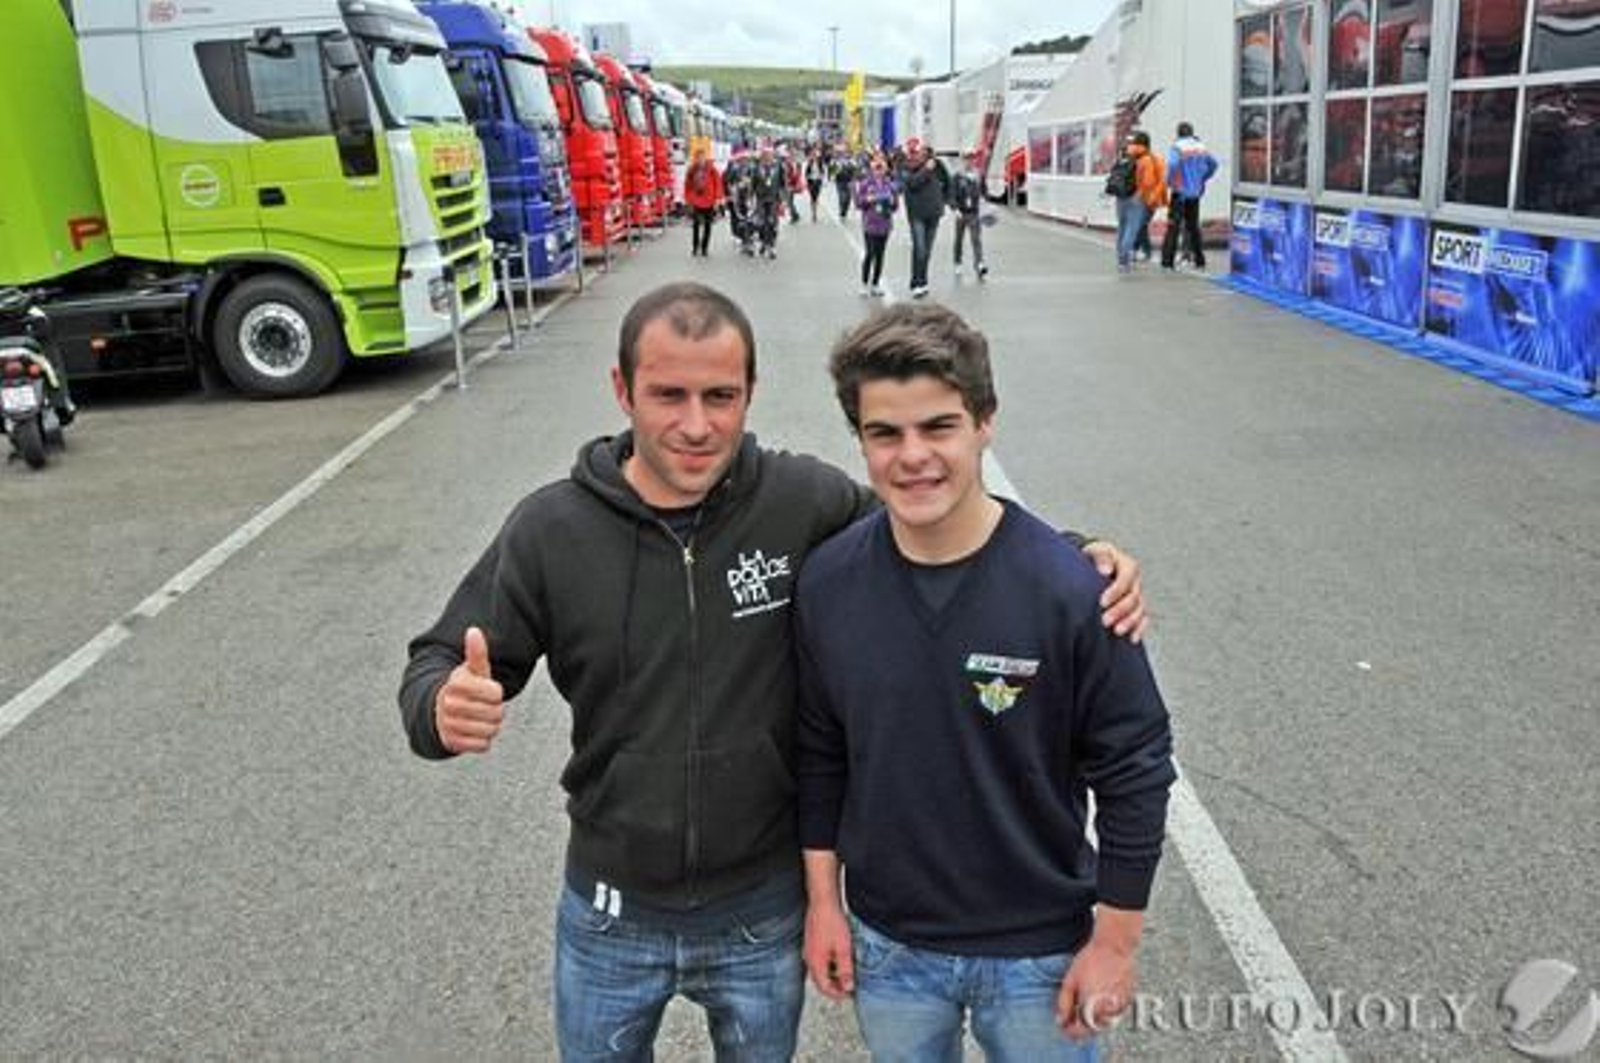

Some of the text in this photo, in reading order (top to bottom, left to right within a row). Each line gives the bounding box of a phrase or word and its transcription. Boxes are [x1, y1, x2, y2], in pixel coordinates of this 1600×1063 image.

[1318, 216, 1349, 244] SPORT
[1435, 234, 1482, 269] SPORT
[727, 556, 790, 588] DOLCE
[738, 550, 766, 568] LA
[732, 583, 771, 605] VITA
